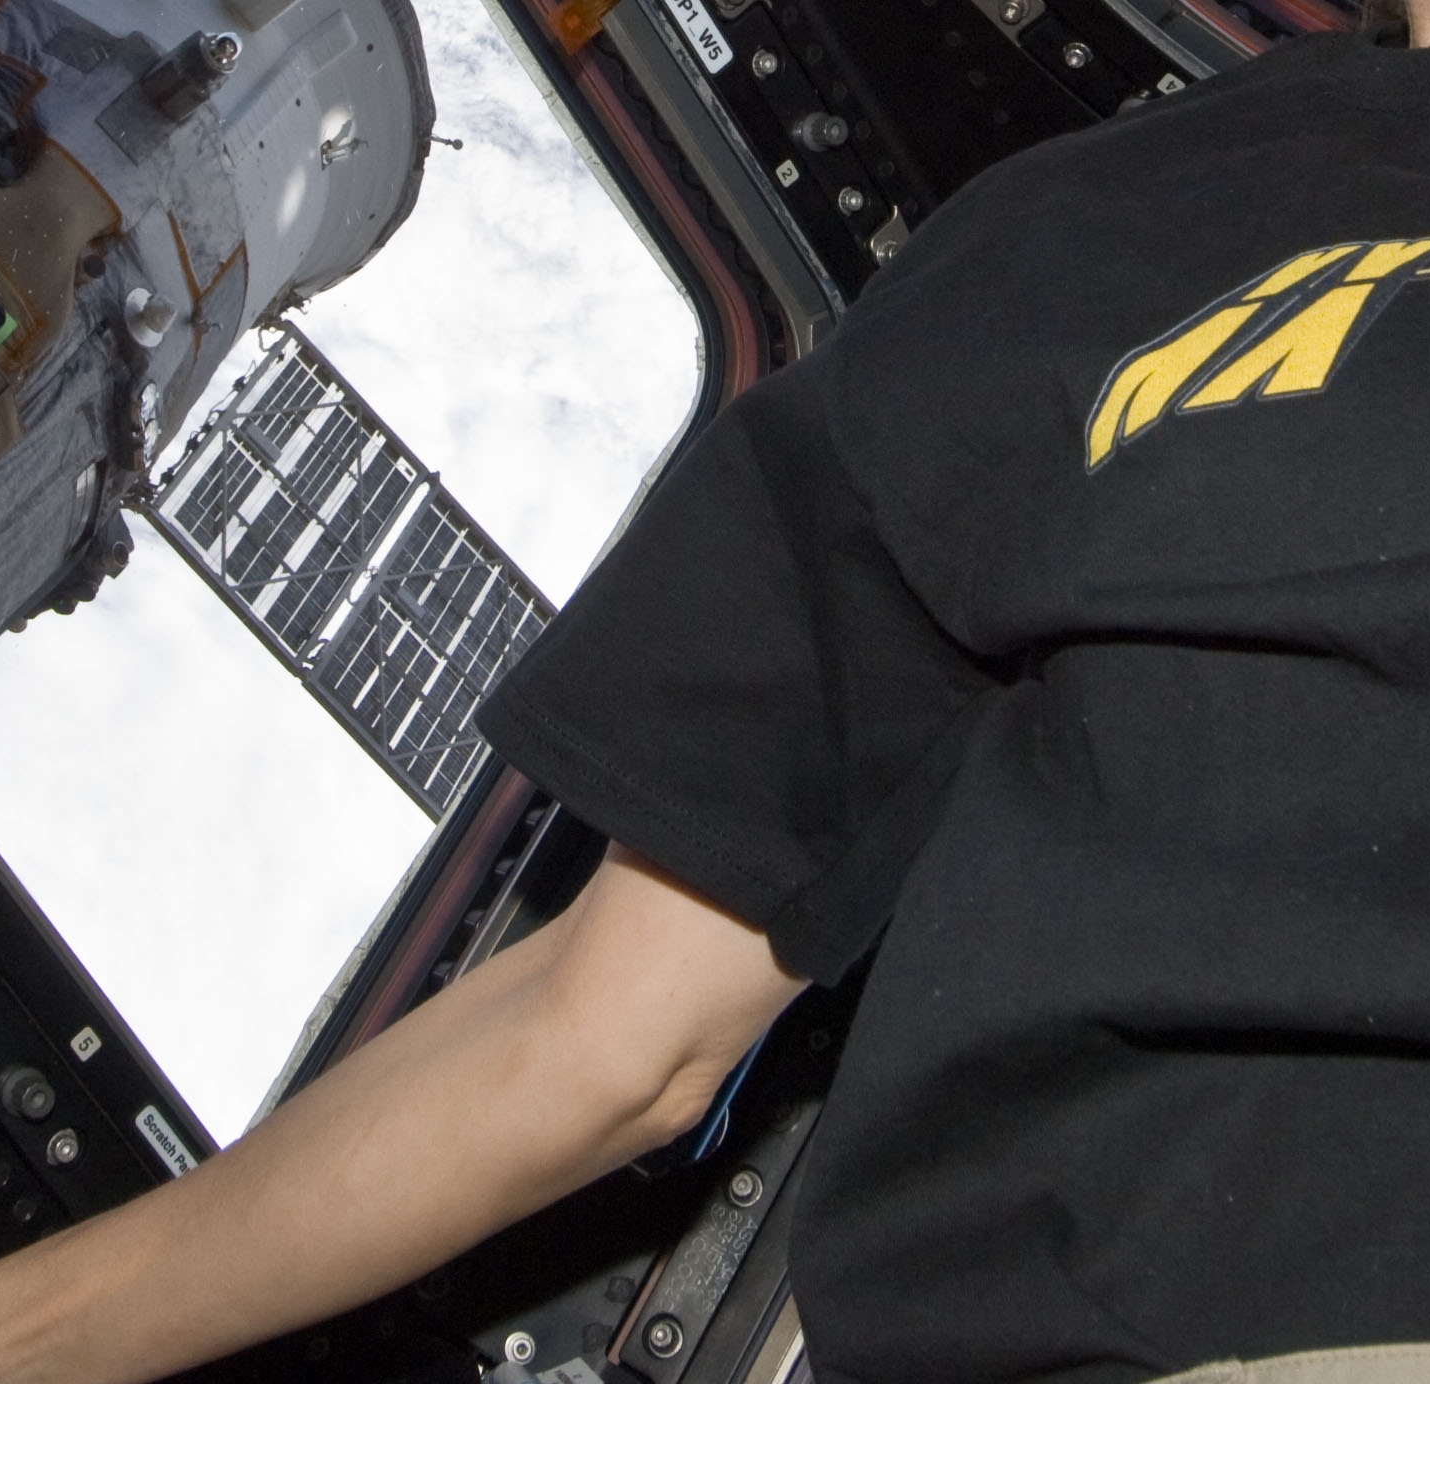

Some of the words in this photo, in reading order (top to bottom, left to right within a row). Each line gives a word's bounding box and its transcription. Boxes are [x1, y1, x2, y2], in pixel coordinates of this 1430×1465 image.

[781, 167, 793, 181] 2
[78, 1035, 94, 1052] 5
[142, 1113, 180, 1158] Scratch
[173, 1154, 193, 1175] Pa
[728, 1216, 759, 1262] ASSY
